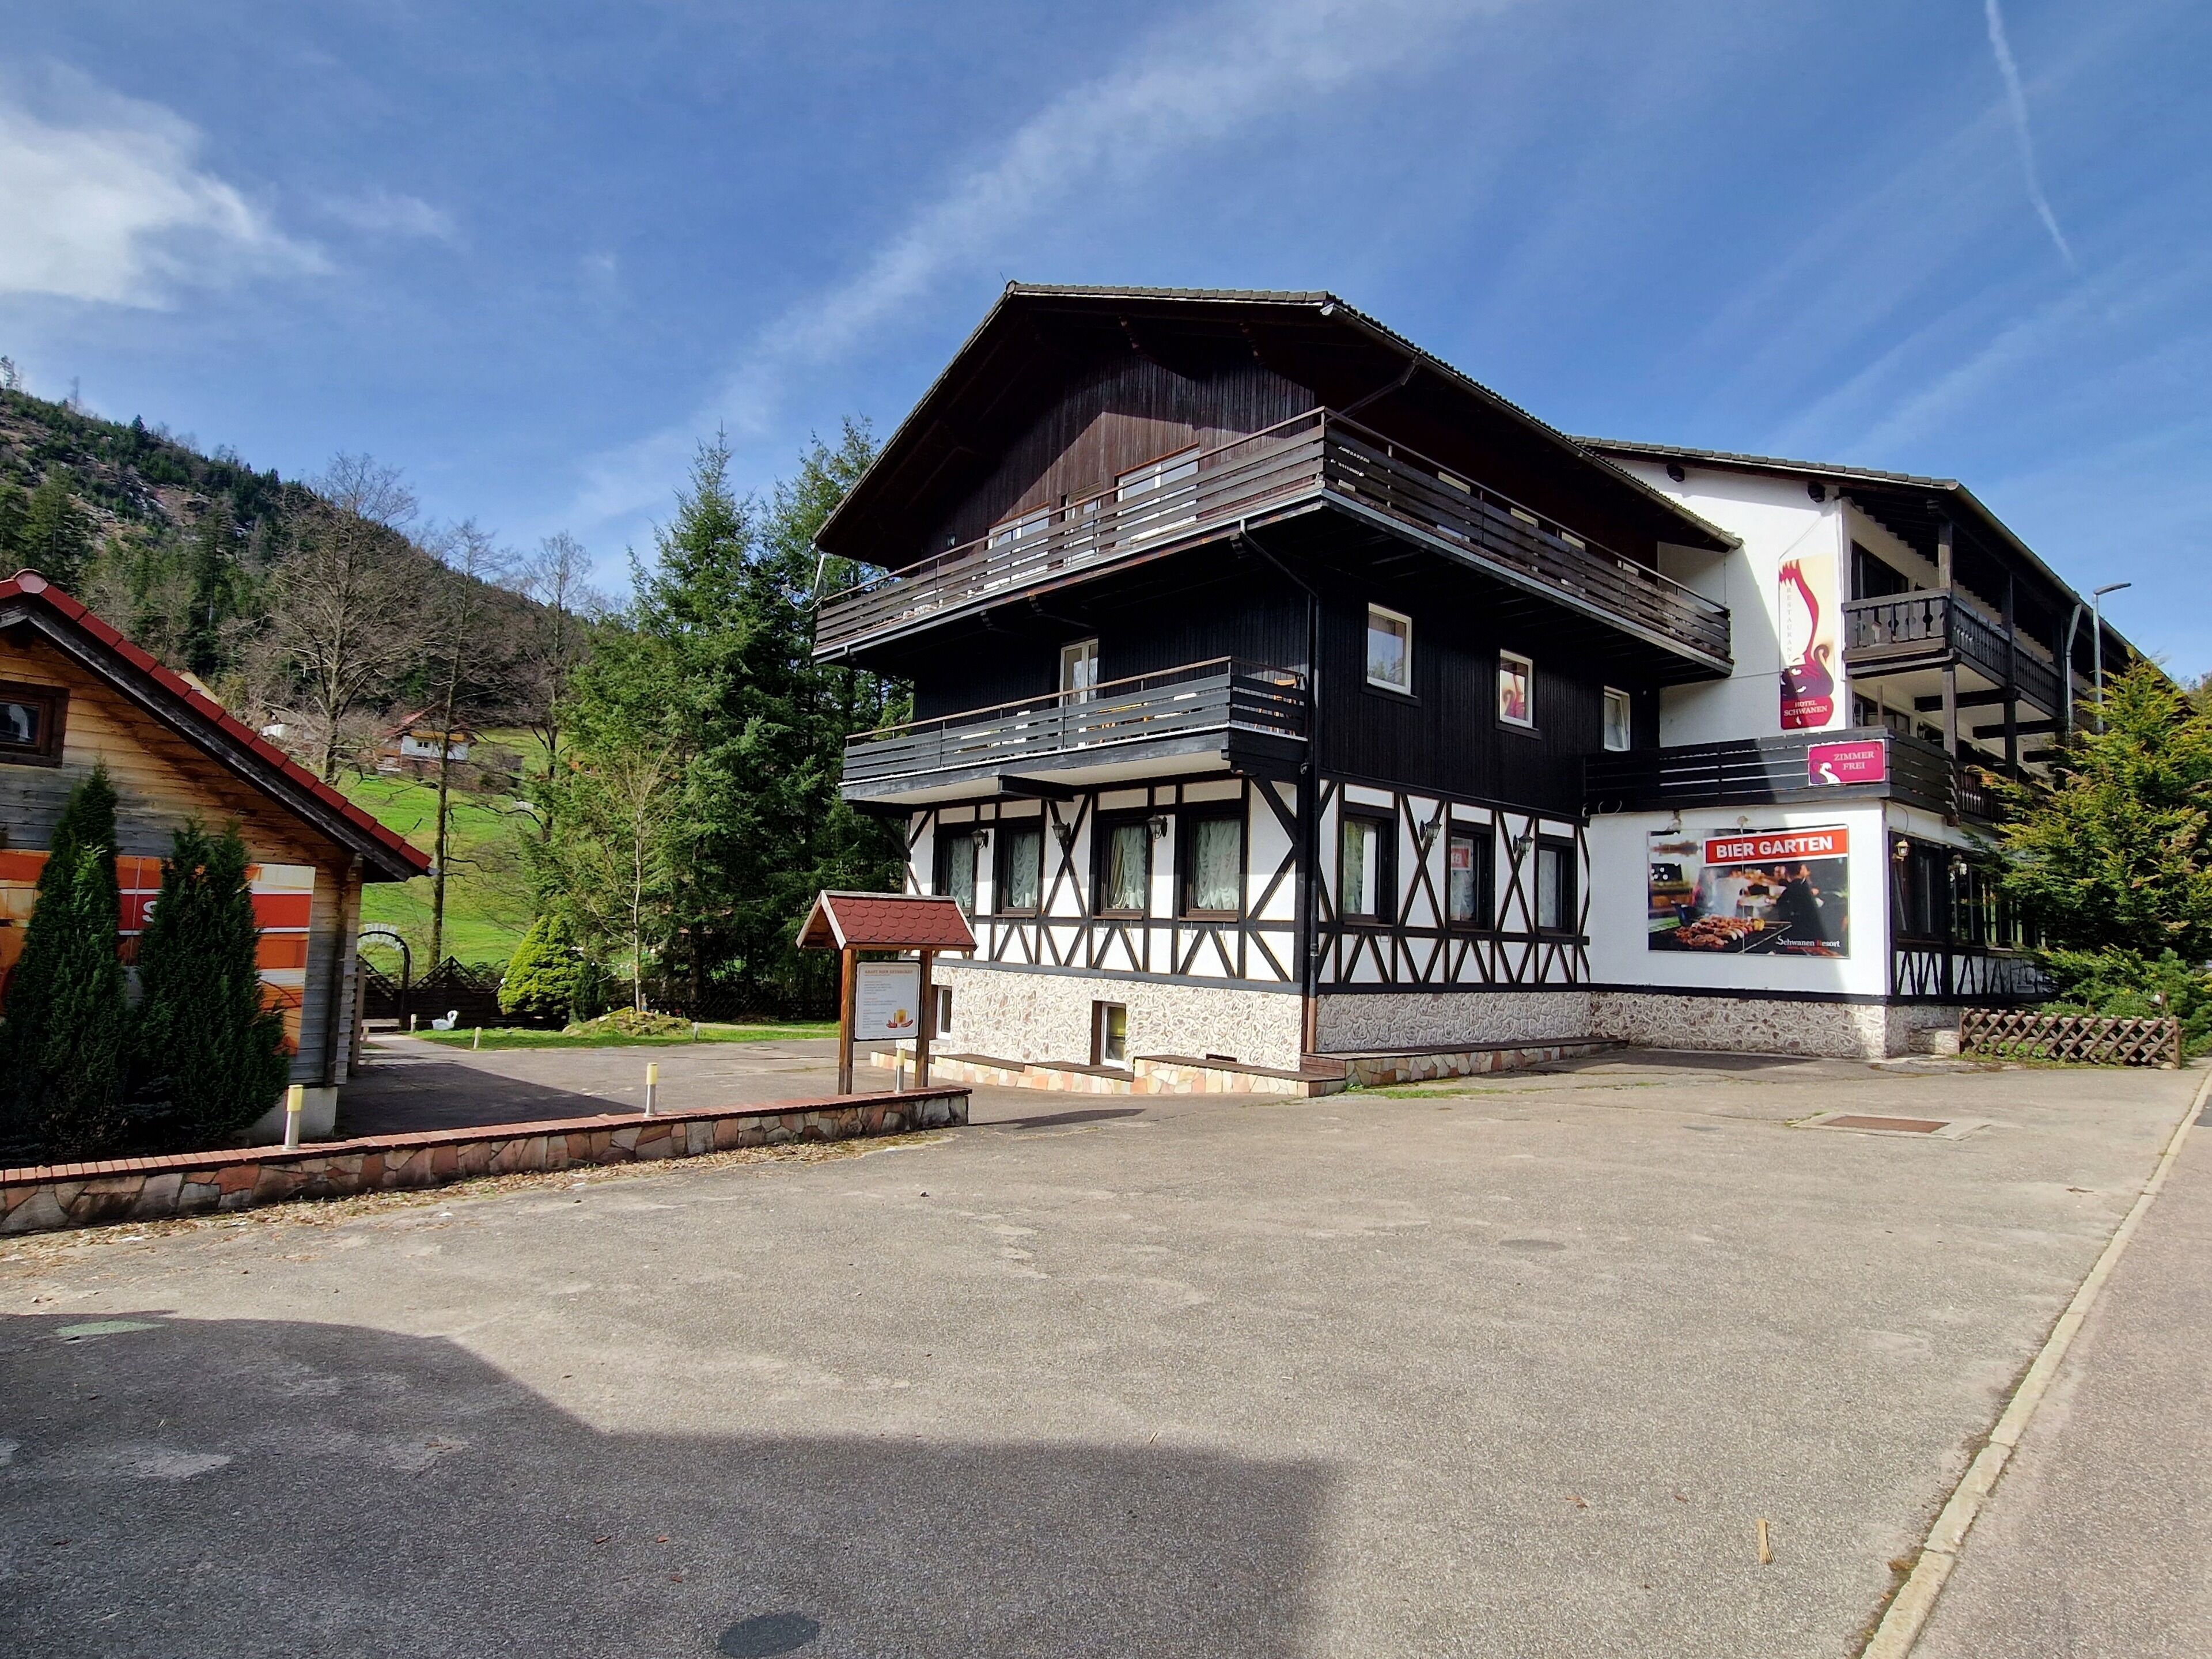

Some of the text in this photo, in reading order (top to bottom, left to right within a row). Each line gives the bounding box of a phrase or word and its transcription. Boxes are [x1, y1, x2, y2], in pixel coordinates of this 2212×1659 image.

[1784, 705, 1828, 716] SCHWANEN
[1834, 751, 1874, 761] ZIMMER
[1843, 762, 1865, 770] FREI
[1716, 836, 1833, 858] BIER GARTEN
[365, 923, 398, 934] BIER
[1775, 935, 1815, 946] Schwanen
